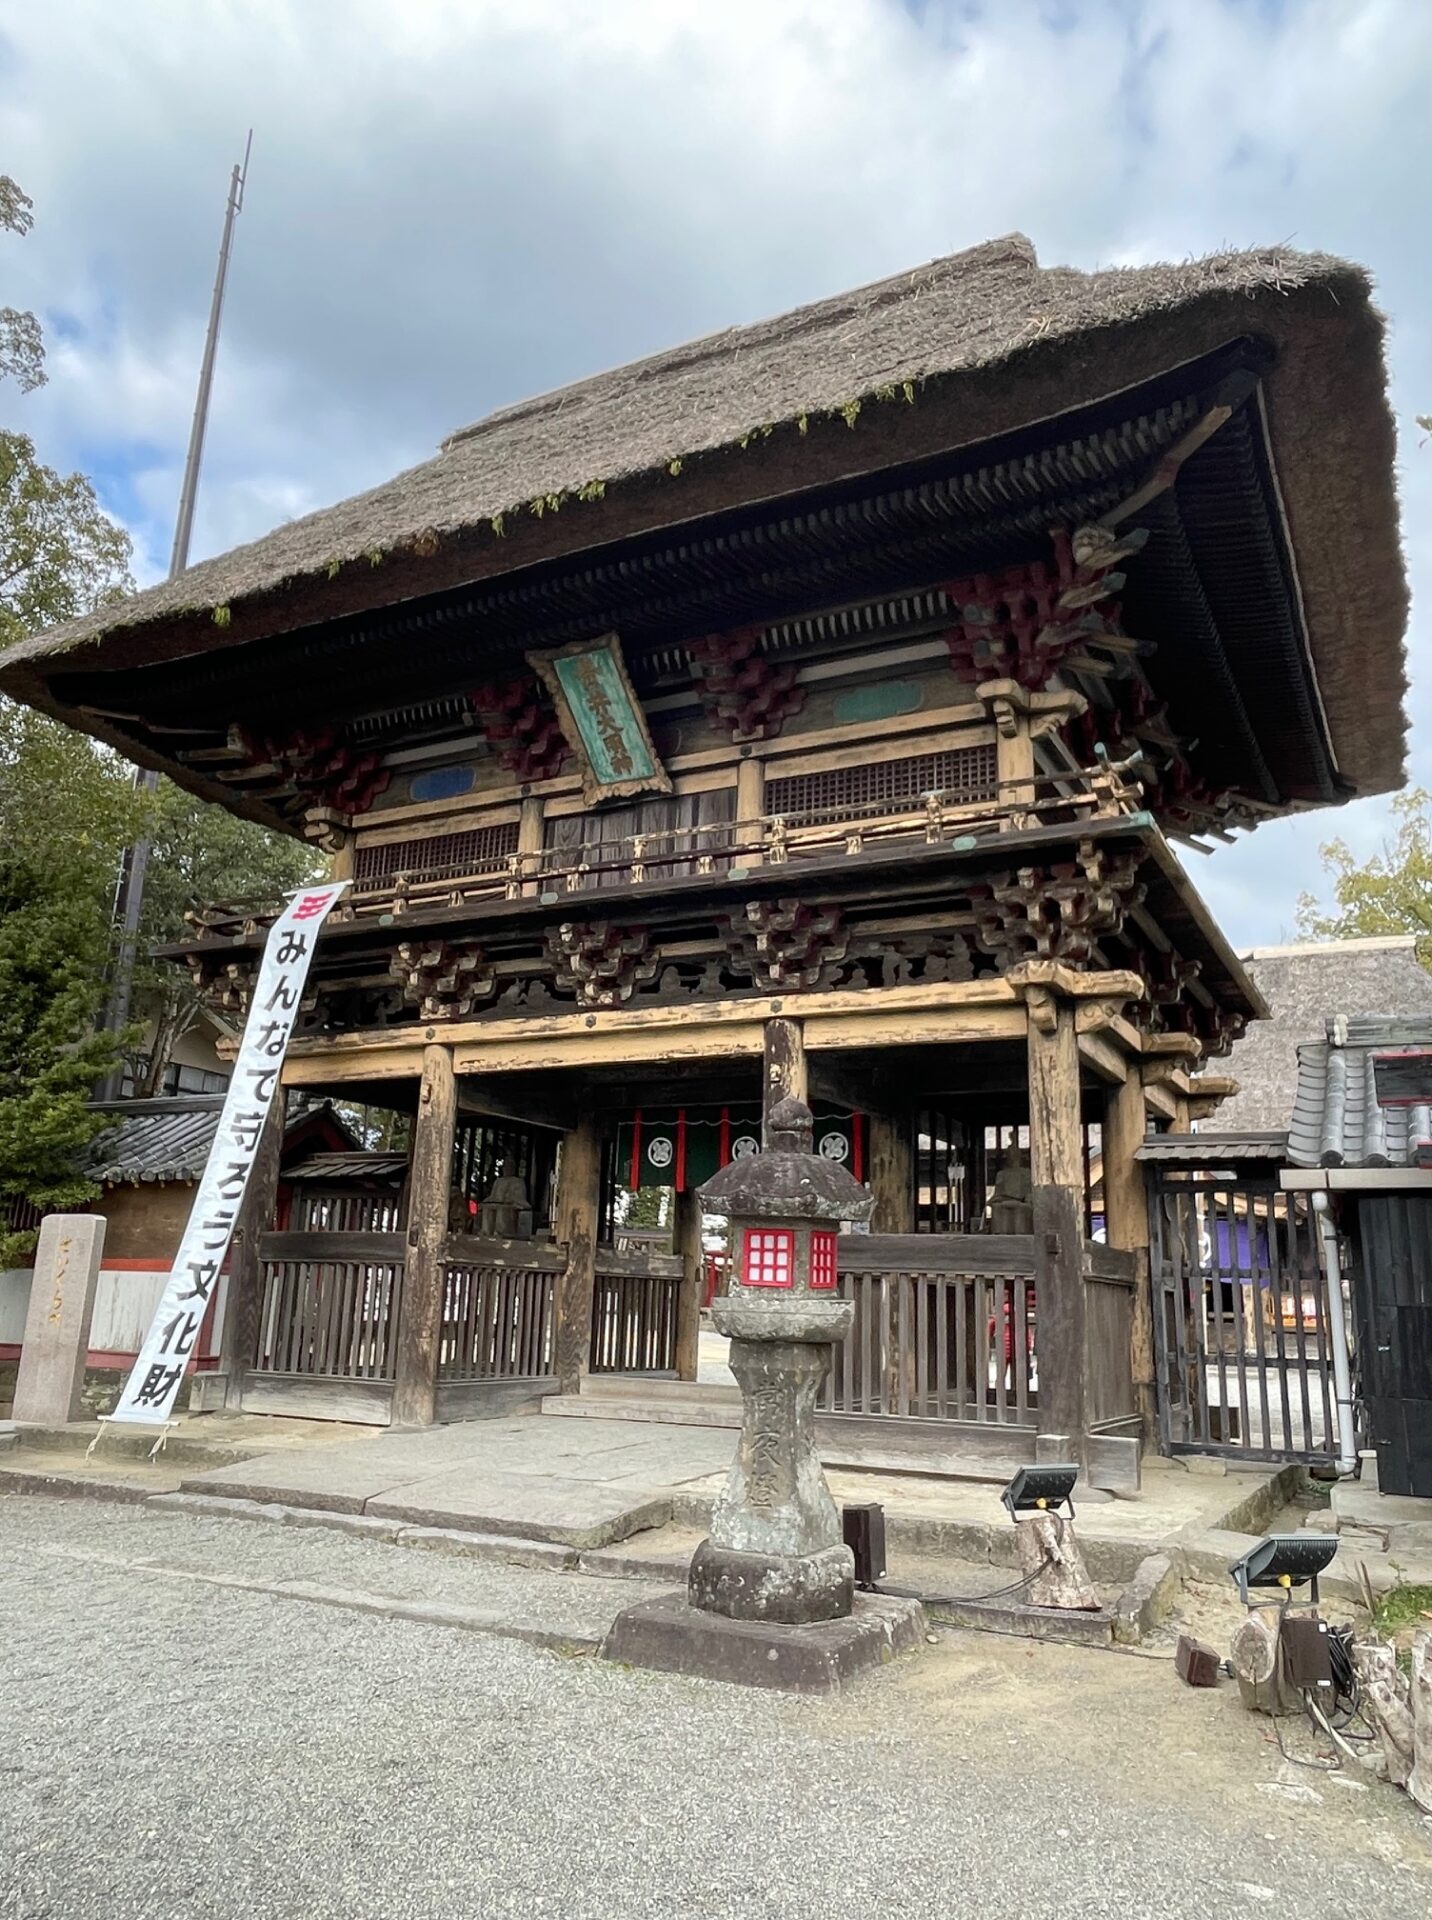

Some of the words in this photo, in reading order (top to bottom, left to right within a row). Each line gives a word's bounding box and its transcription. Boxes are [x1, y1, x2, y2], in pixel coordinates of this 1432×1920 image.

[131, 929, 308, 1407] みんなで守ろう文化財
